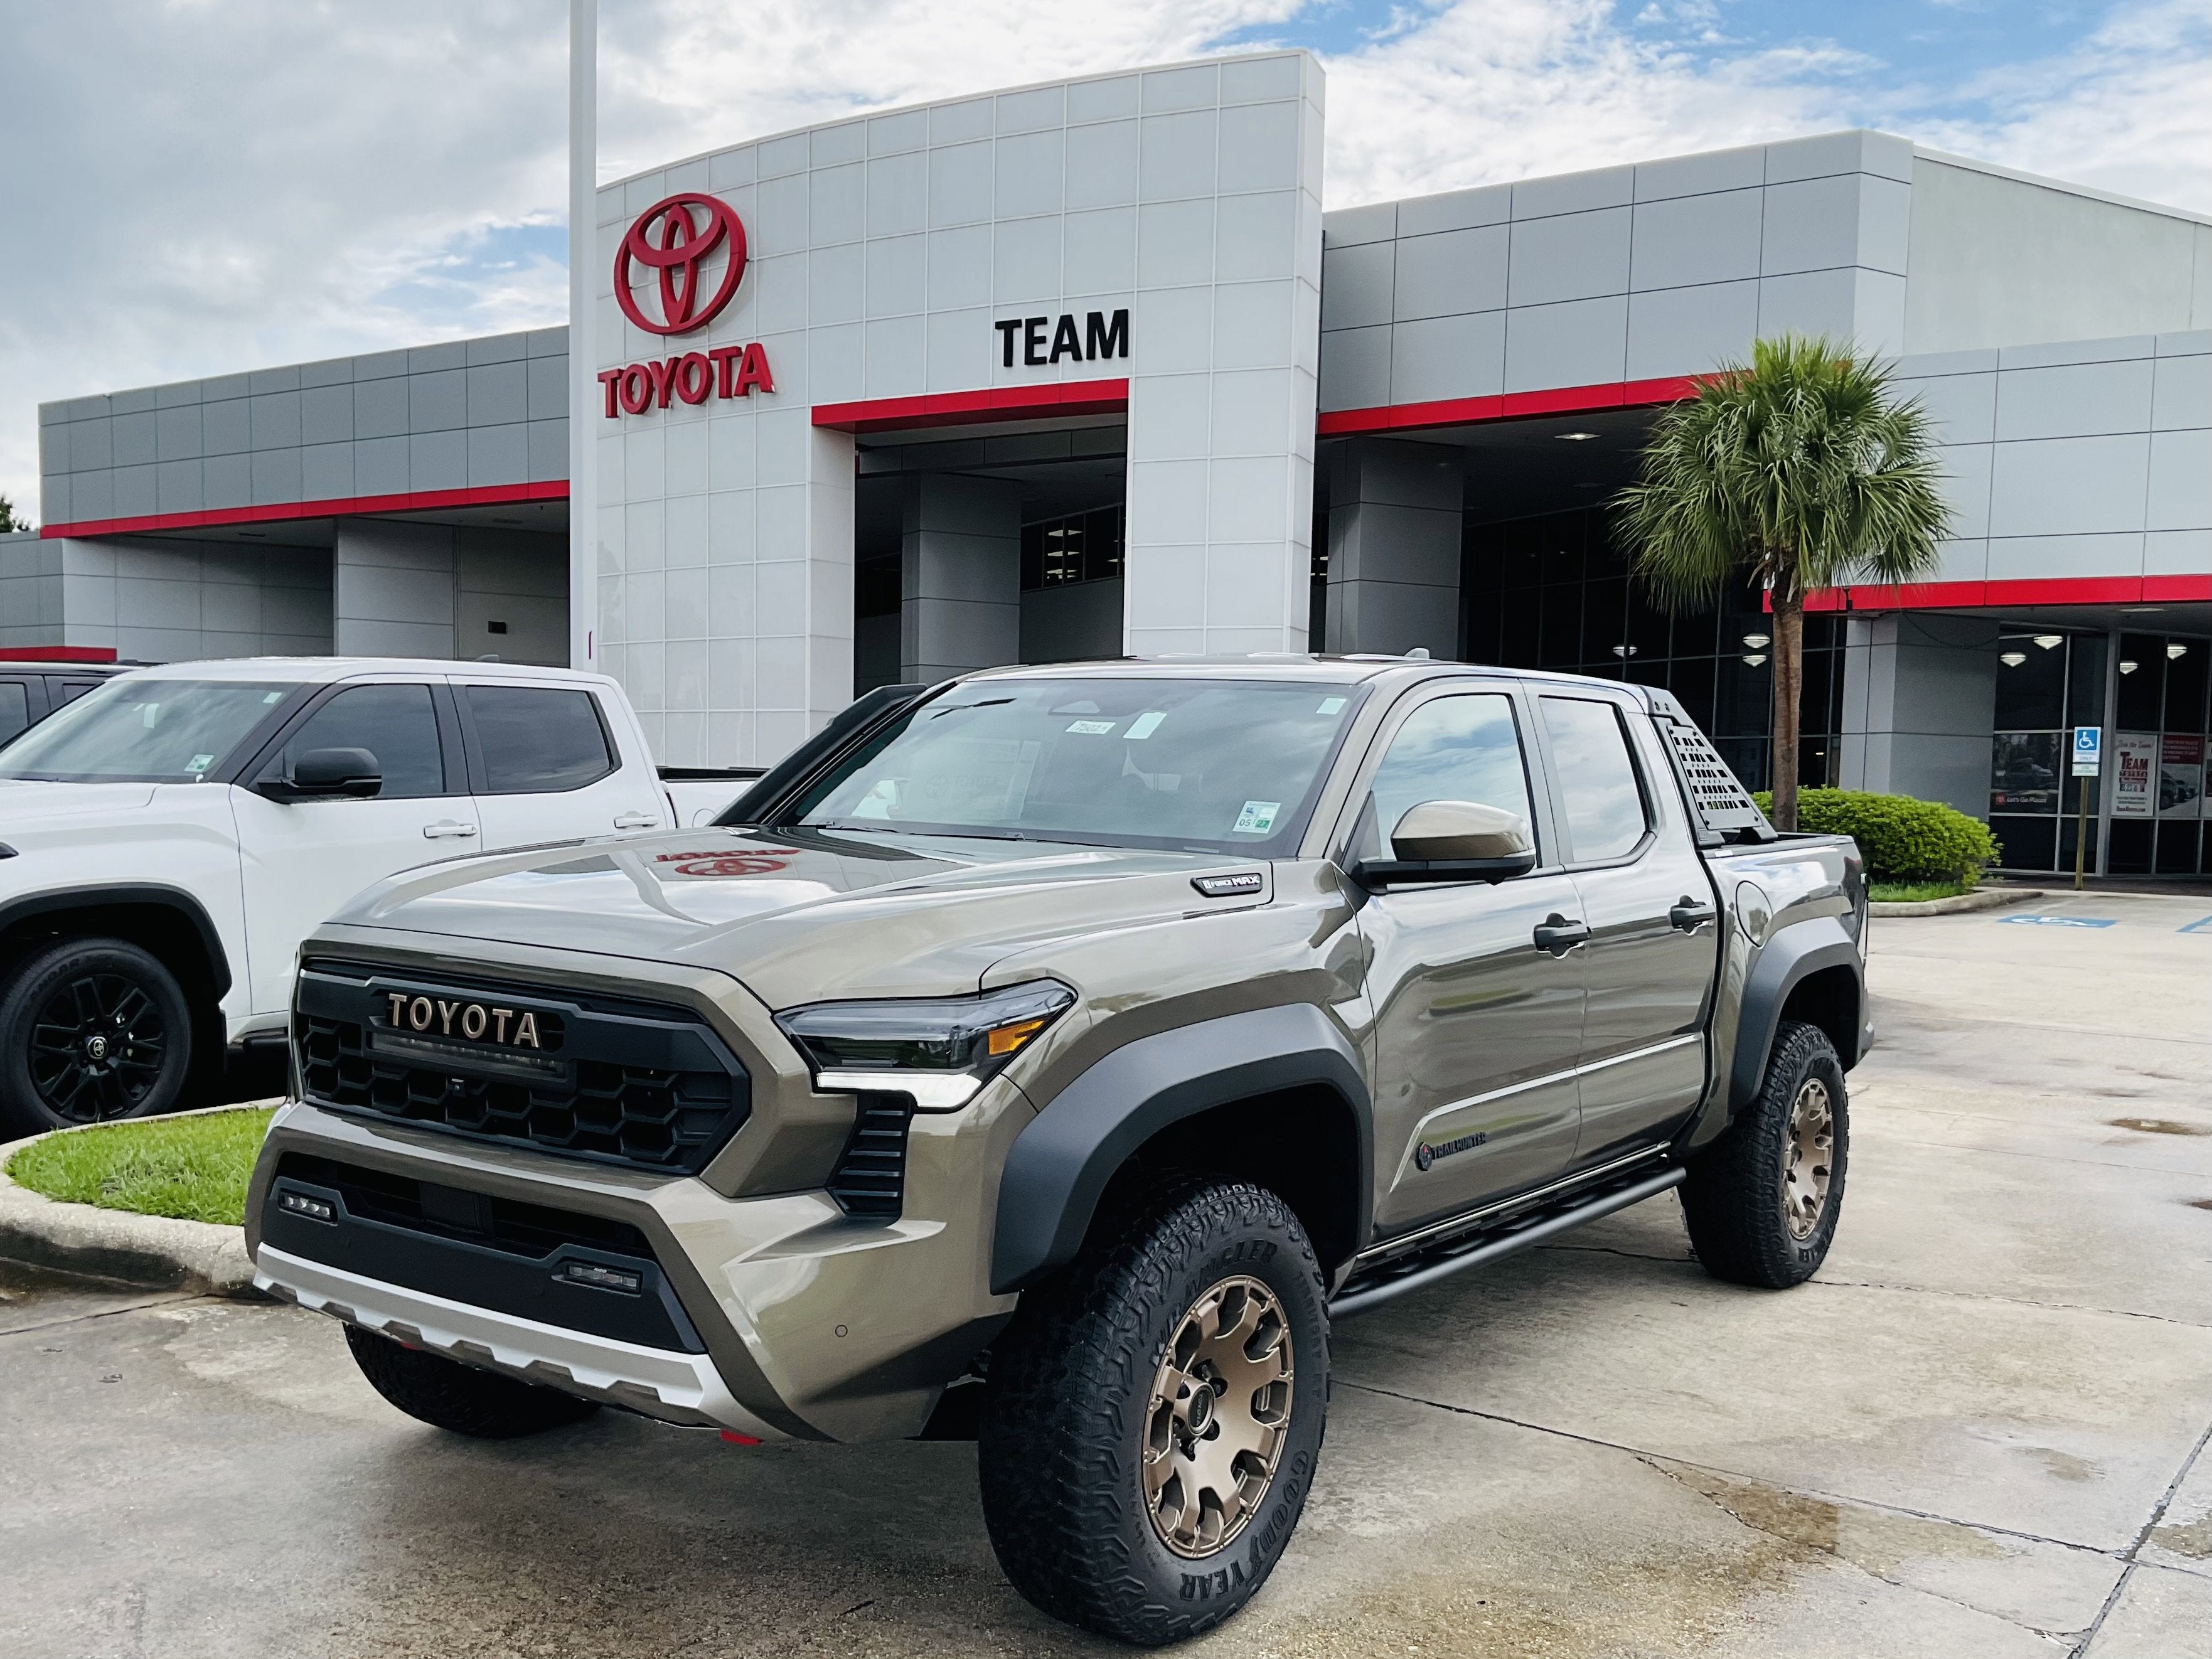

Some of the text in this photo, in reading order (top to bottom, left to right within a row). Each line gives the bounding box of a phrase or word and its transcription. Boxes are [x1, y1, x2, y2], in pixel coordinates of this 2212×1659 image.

[995, 309, 1129, 368] TEAM
[598, 342, 775, 419] TOYOTA
[2120, 751, 2149, 770] TEAM
[1239, 819, 1270, 828] 05 27
[388, 993, 539, 1048] TOYOTA
